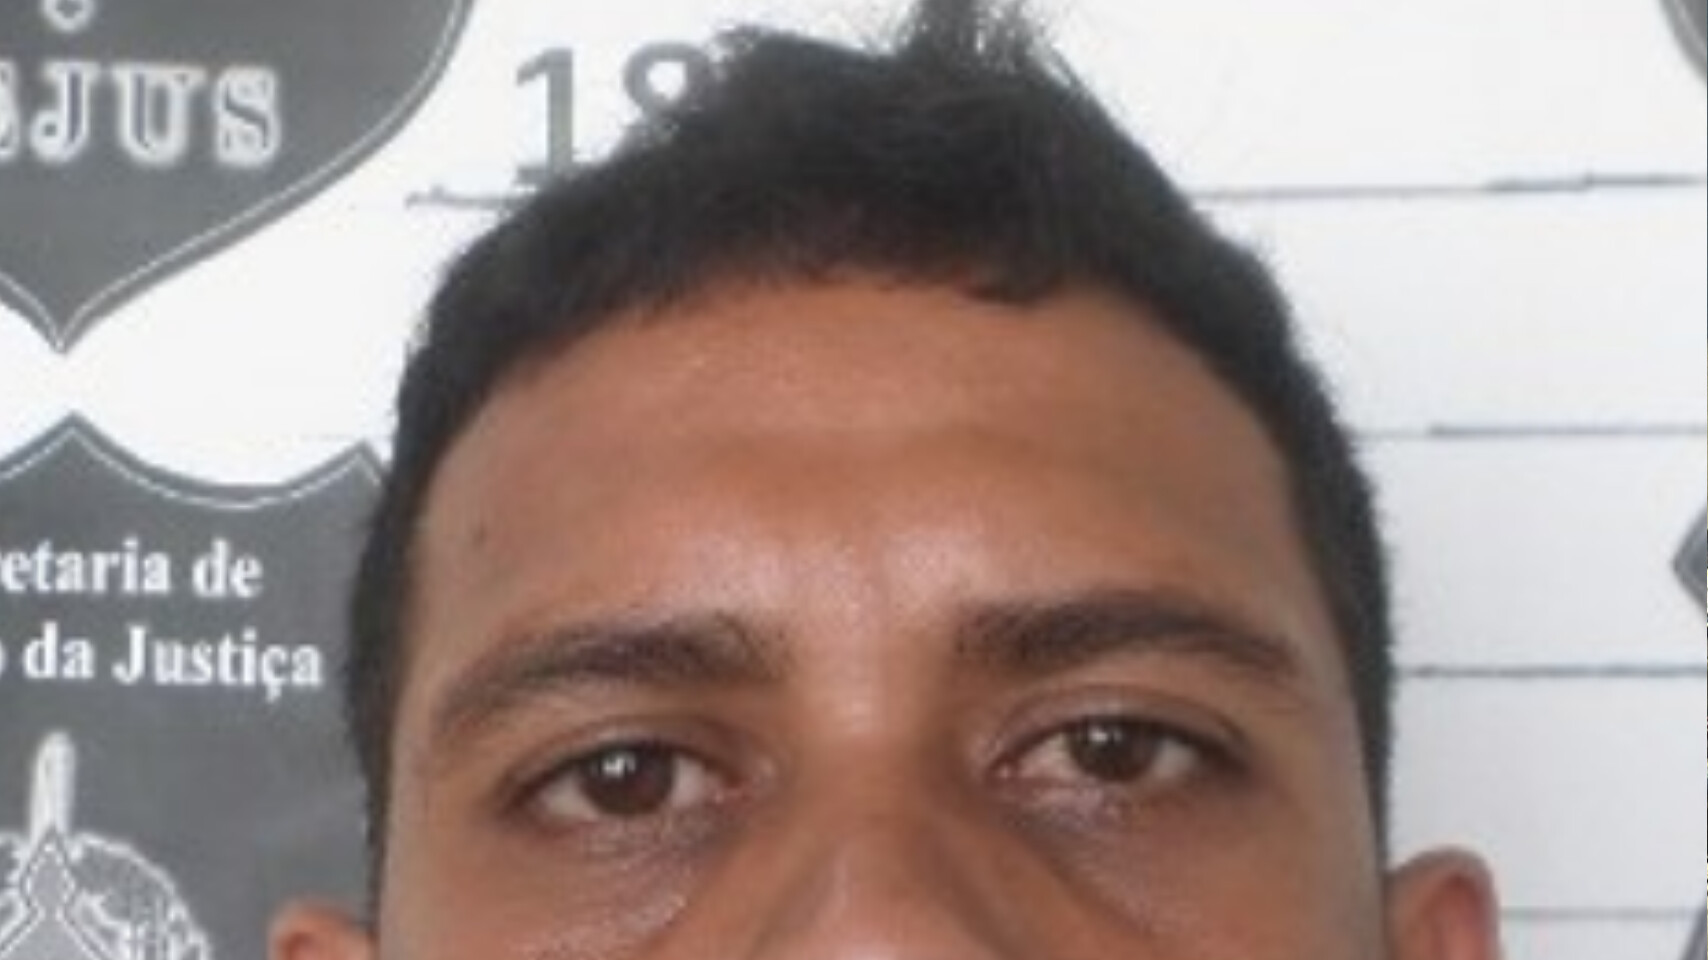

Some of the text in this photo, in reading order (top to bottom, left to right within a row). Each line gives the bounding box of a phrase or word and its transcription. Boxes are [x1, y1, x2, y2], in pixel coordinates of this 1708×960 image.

[191, 537, 264, 598] de
[22, 620, 326, 702] da Justiça
